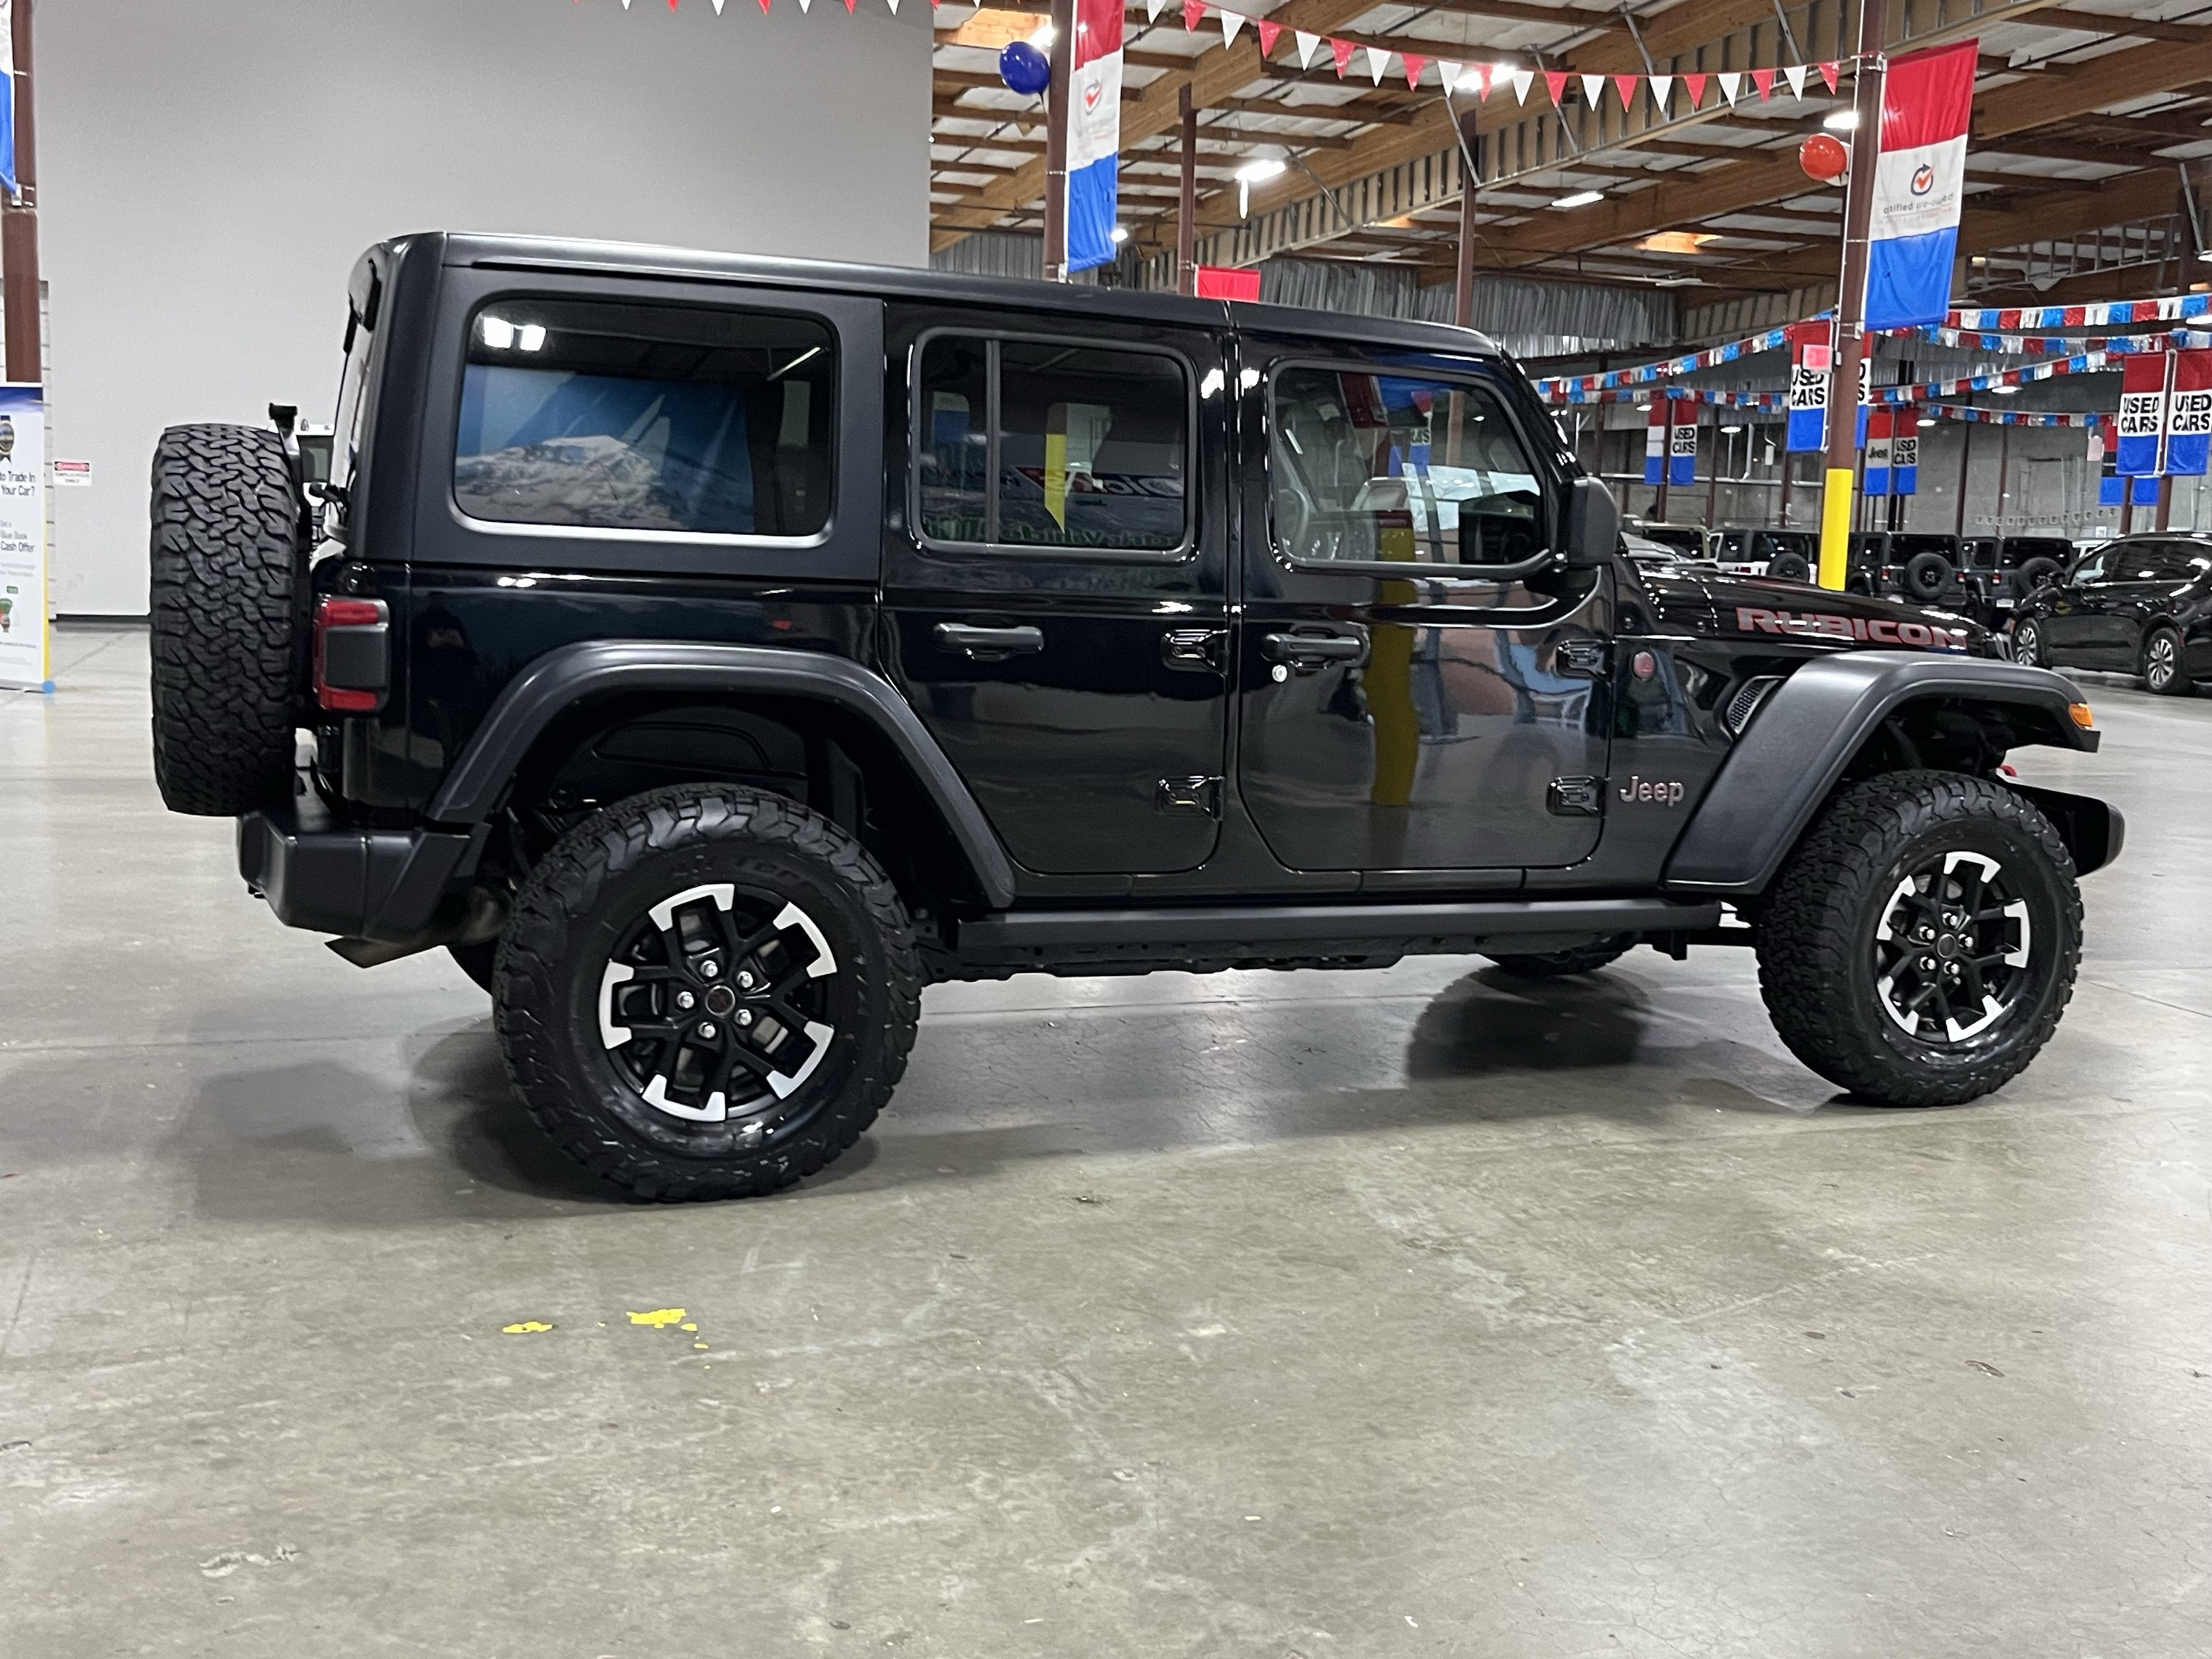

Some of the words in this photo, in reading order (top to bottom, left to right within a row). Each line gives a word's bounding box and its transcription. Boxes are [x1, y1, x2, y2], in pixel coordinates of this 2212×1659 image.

[2123, 396, 2159, 414] USED
[2121, 415, 2158, 433] CARS
[1736, 607, 1967, 648] RUBICON
[1620, 775, 1684, 807] Jeep
